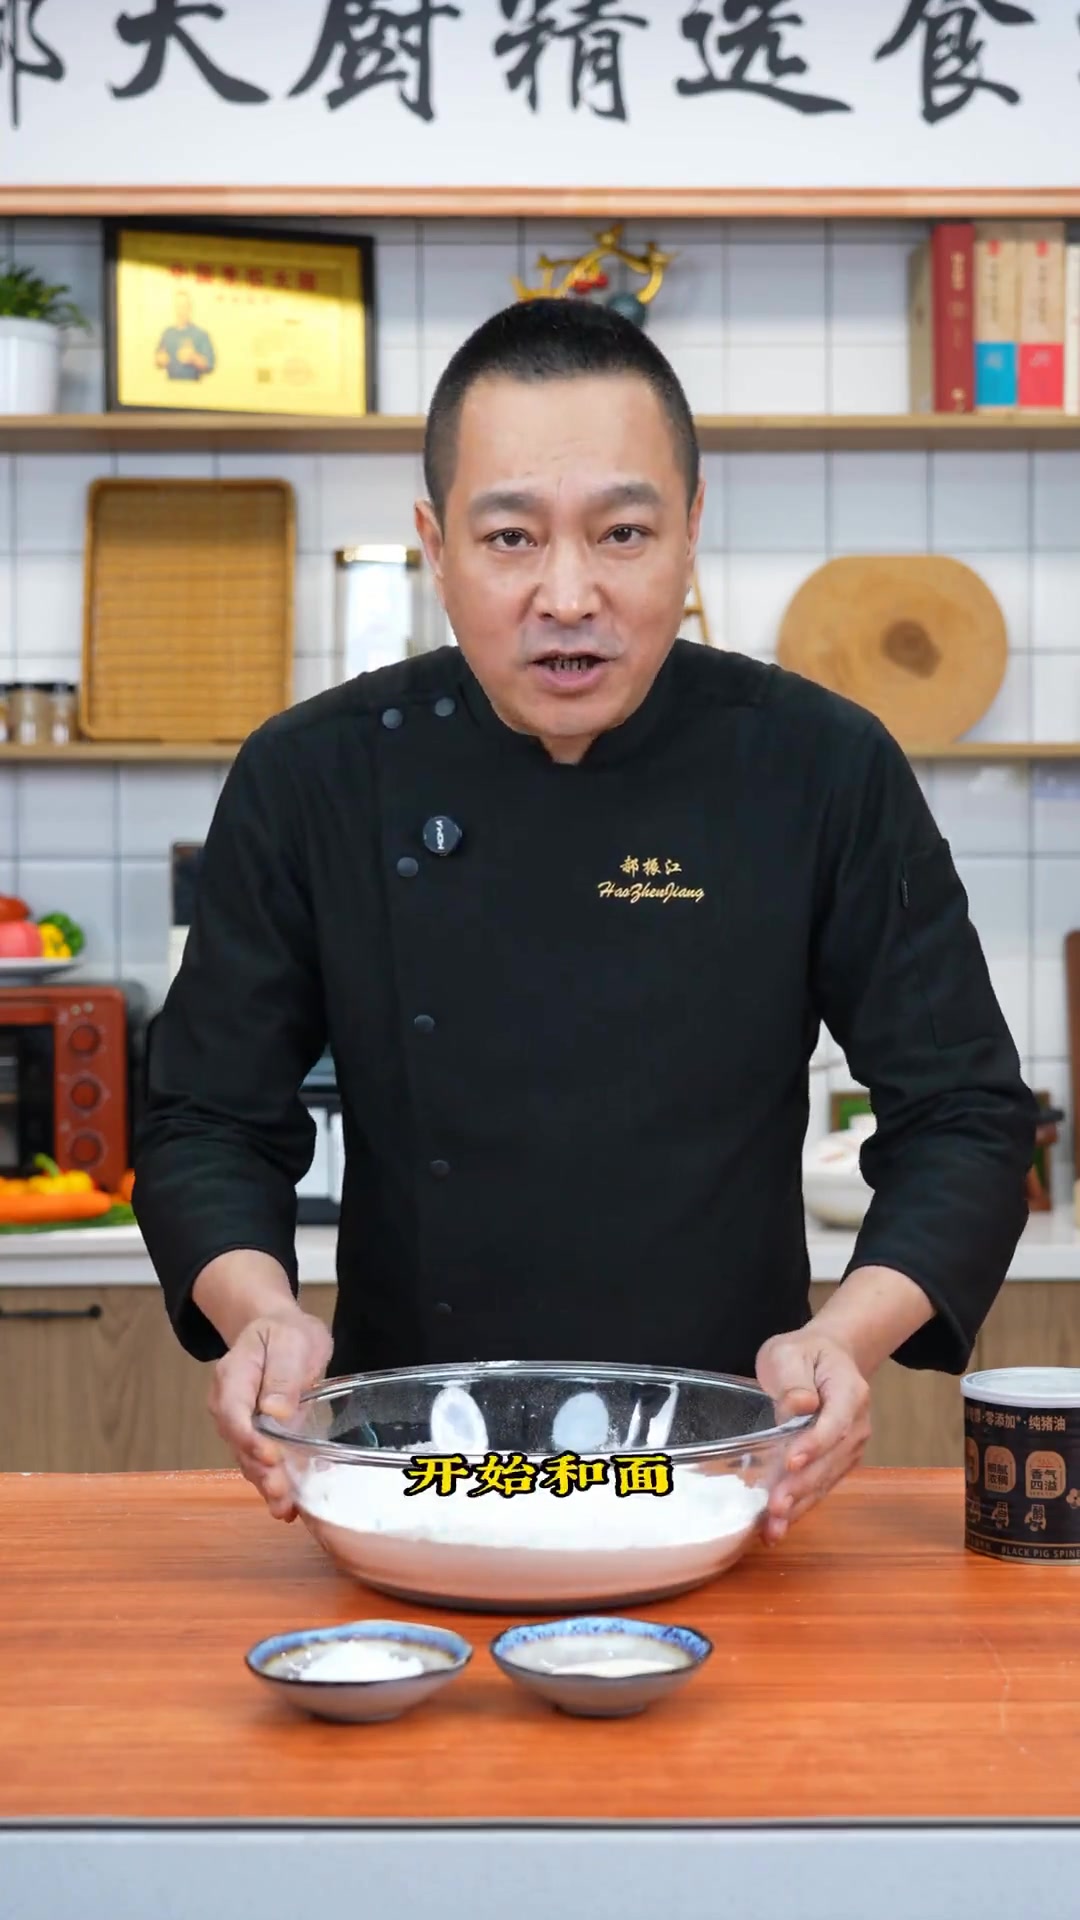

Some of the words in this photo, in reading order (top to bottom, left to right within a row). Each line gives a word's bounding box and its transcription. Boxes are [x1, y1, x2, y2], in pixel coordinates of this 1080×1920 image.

[0, 0, 1080, 128] 大厨精选食
[619, 855, 682, 878] 郝振江
[598, 881, 704, 903] HaoZhenJiang
[1030, 1468, 1057, 1480] 香气
[1030, 1480, 1057, 1491] 四溢
[1001, 1545, 1030, 1557] BLACK
[1033, 1549, 1049, 1558] PIG
